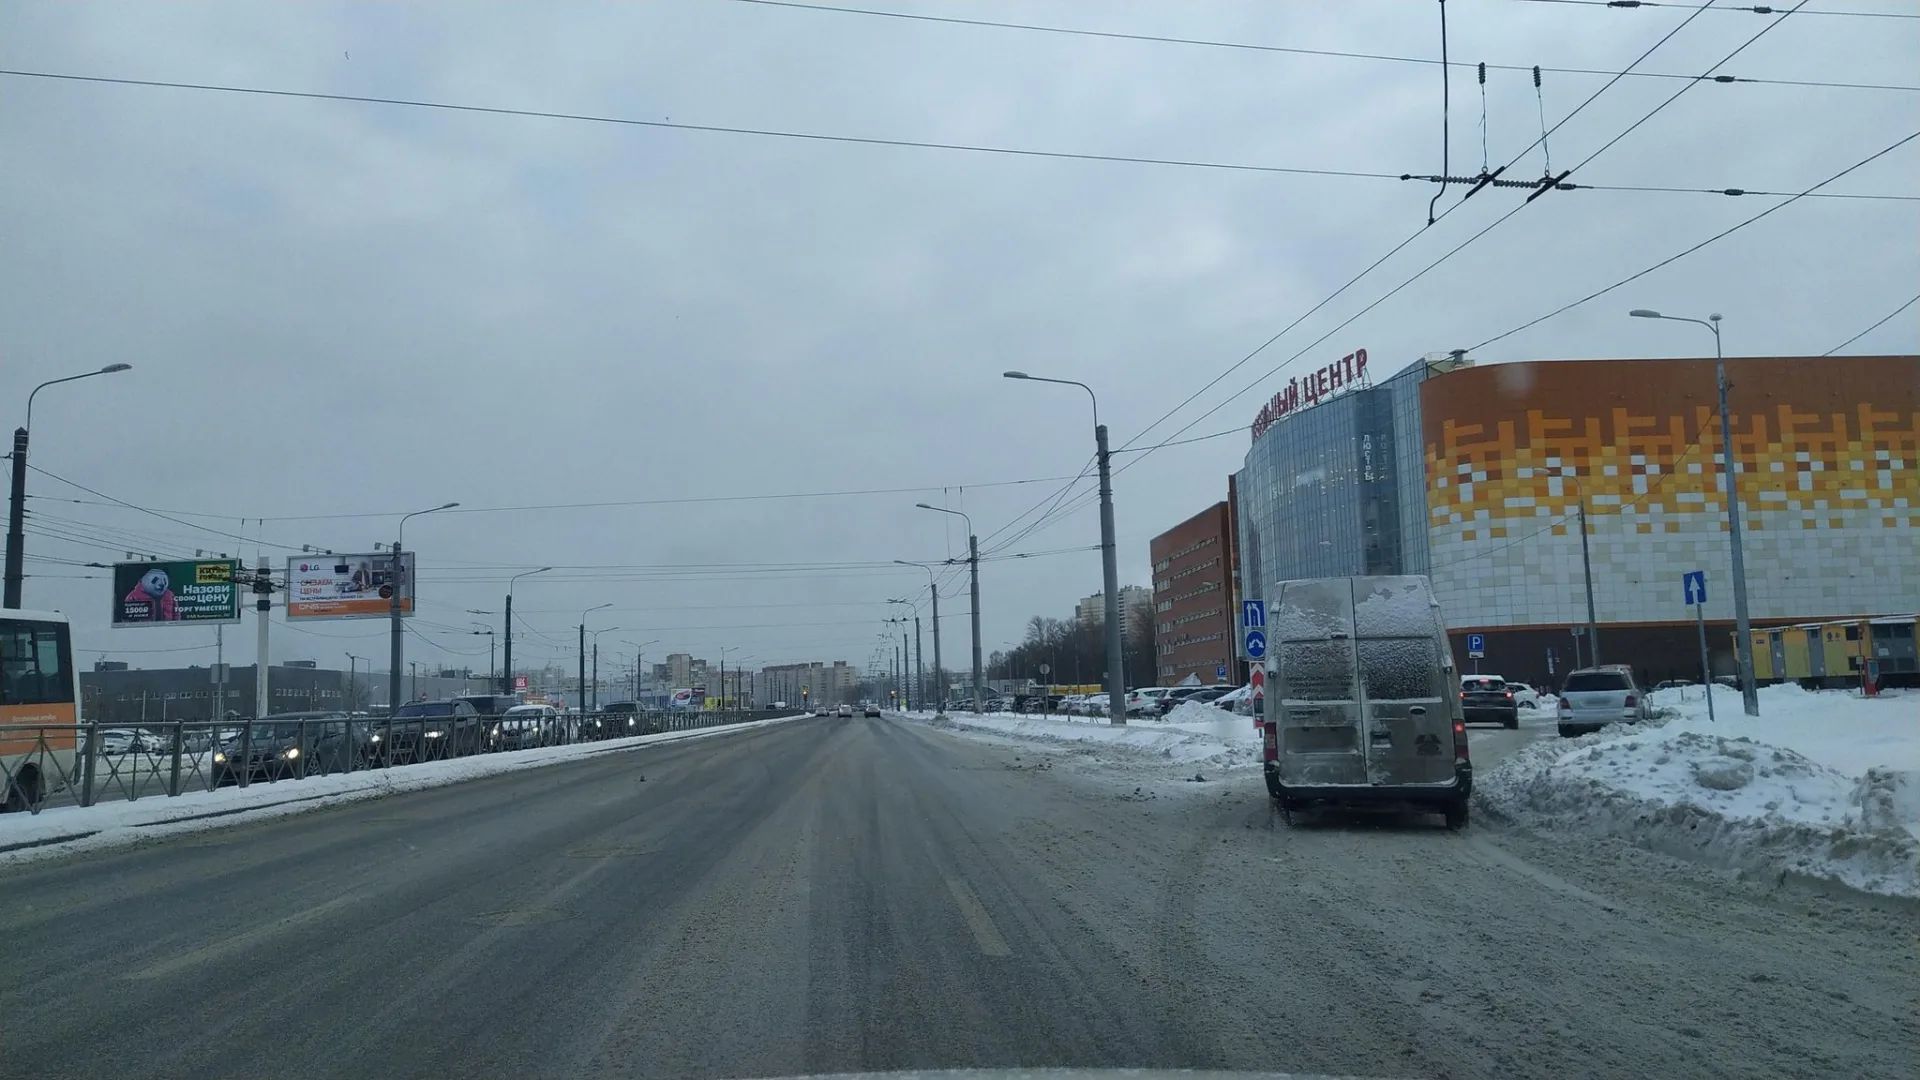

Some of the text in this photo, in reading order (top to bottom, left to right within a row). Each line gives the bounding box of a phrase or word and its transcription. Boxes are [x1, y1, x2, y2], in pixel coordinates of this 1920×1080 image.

[1303, 348, 1367, 405] ЦЕНТР
[183, 585, 230, 594] Назови
[196, 593, 230, 604] цену
